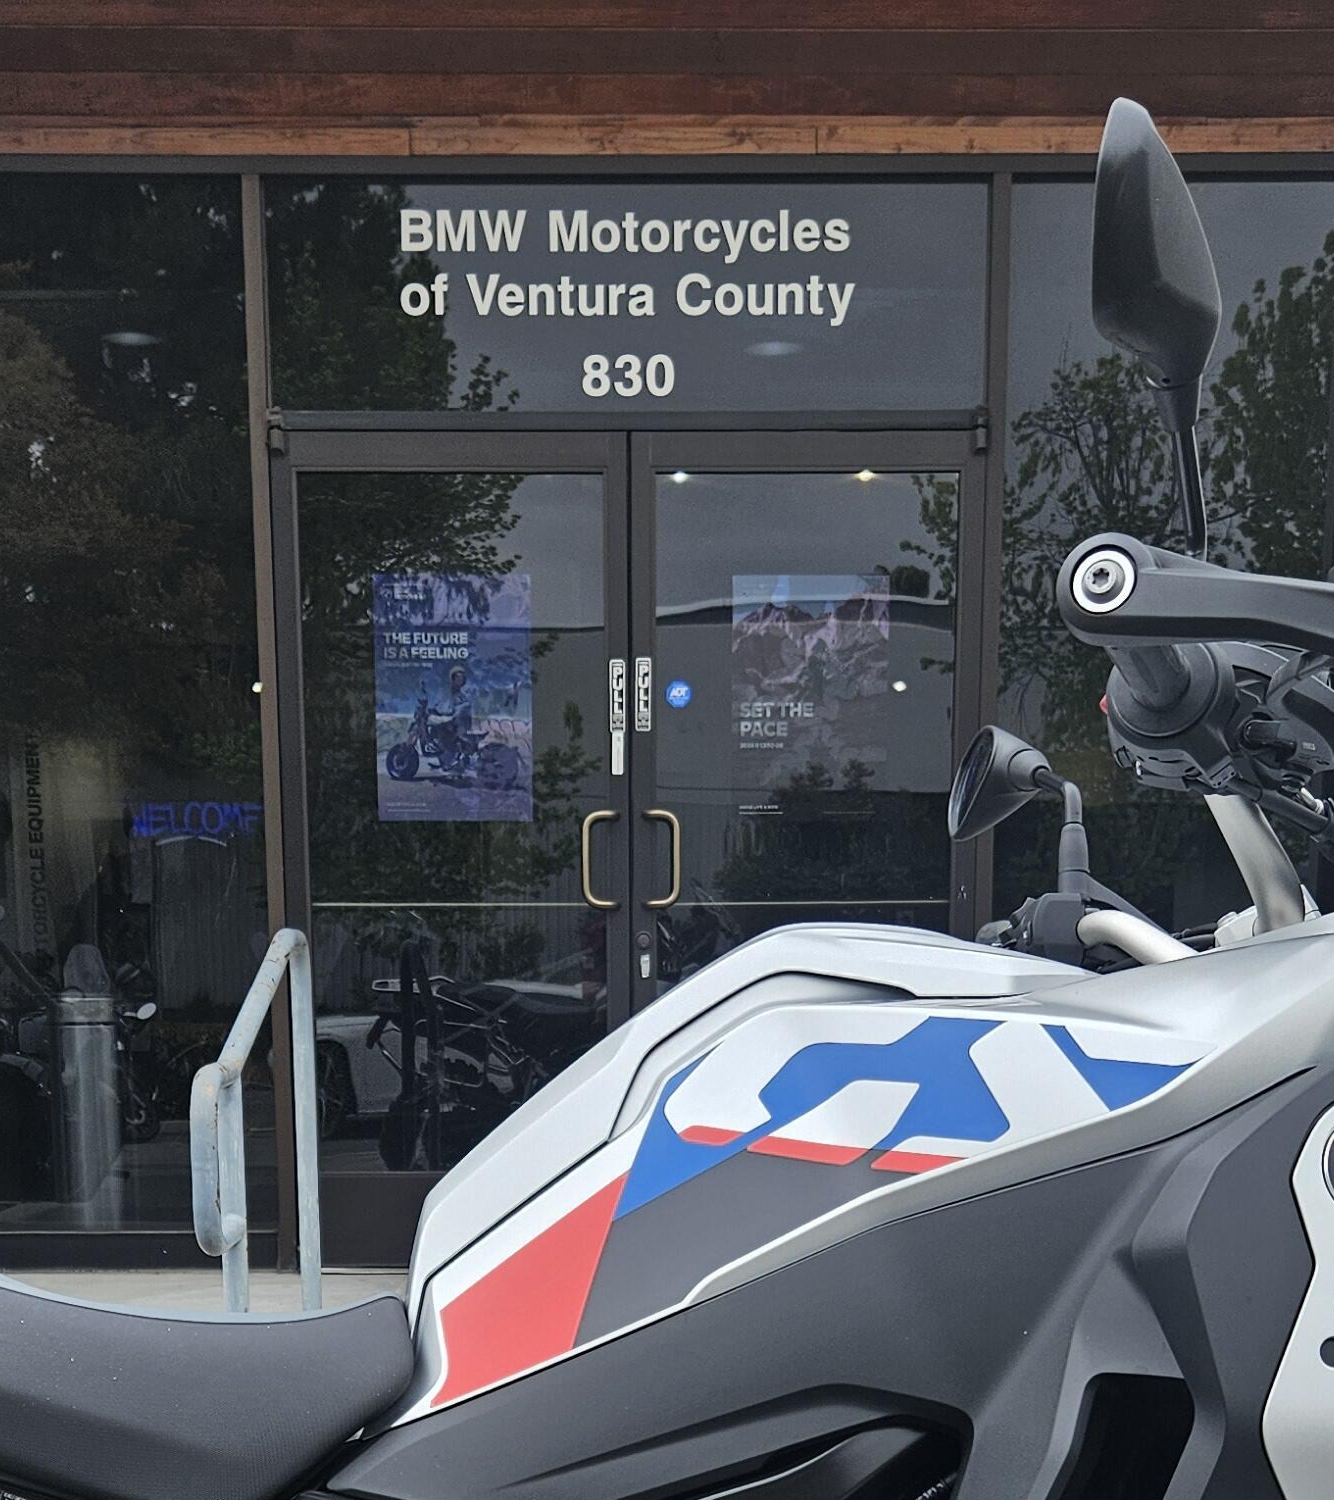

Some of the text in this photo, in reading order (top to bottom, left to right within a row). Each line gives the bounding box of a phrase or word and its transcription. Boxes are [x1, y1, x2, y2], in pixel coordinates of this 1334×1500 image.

[400, 210, 851, 264] BMW Motorcycles
[399, 272, 855, 326] of Ventura County
[581, 353, 676, 398] 830
[382, 632, 469, 645] THE FUTURE
[383, 646, 469, 660] IS A FEELING
[612, 666, 624, 714] PULL
[638, 664, 650, 712] PULL
[670, 687, 689, 698] ADT
[739, 702, 815, 718] SET THE
[739, 721, 788, 737] PACE
